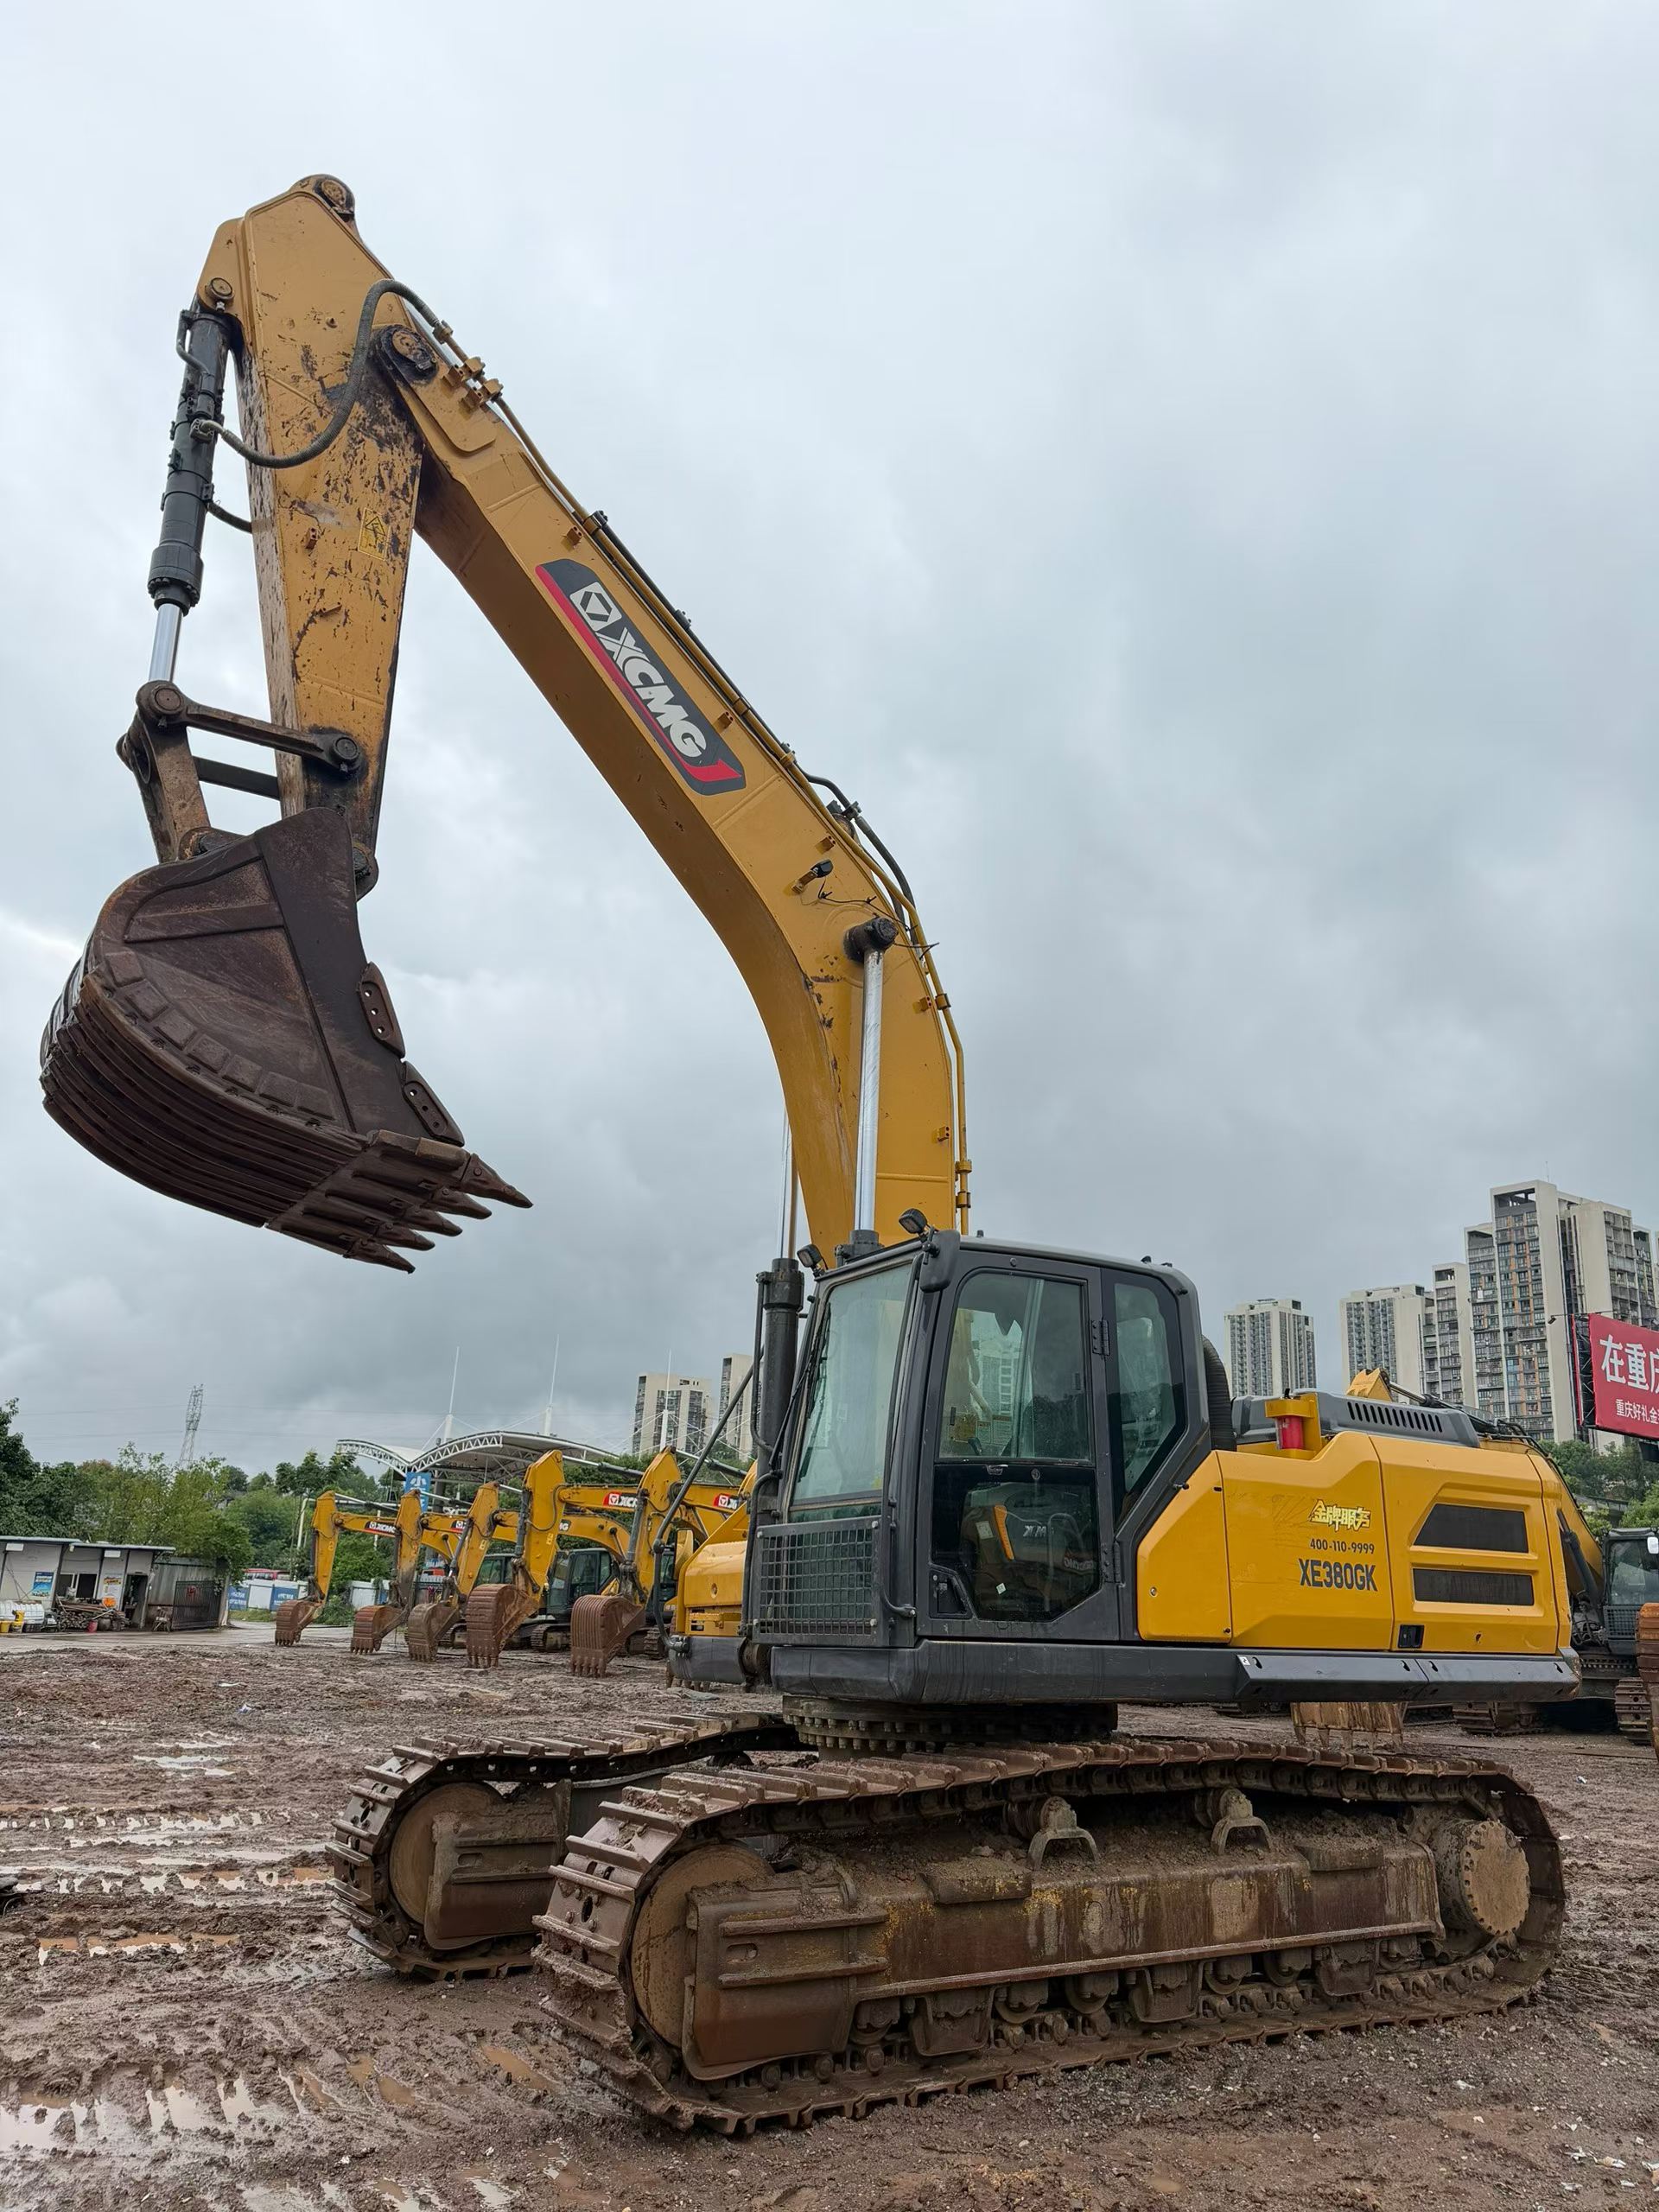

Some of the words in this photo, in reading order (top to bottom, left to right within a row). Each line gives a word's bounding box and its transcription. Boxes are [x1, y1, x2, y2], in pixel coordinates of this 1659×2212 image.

[595, 626, 707, 758] XCMG
[1616, 1398, 1659, 1424] 重庆好礼金
[1308, 1499, 1371, 1532] 金牌服务
[1310, 1539, 1375, 1554] 400-110-9999
[1298, 1558, 1378, 1592] XE380GK
